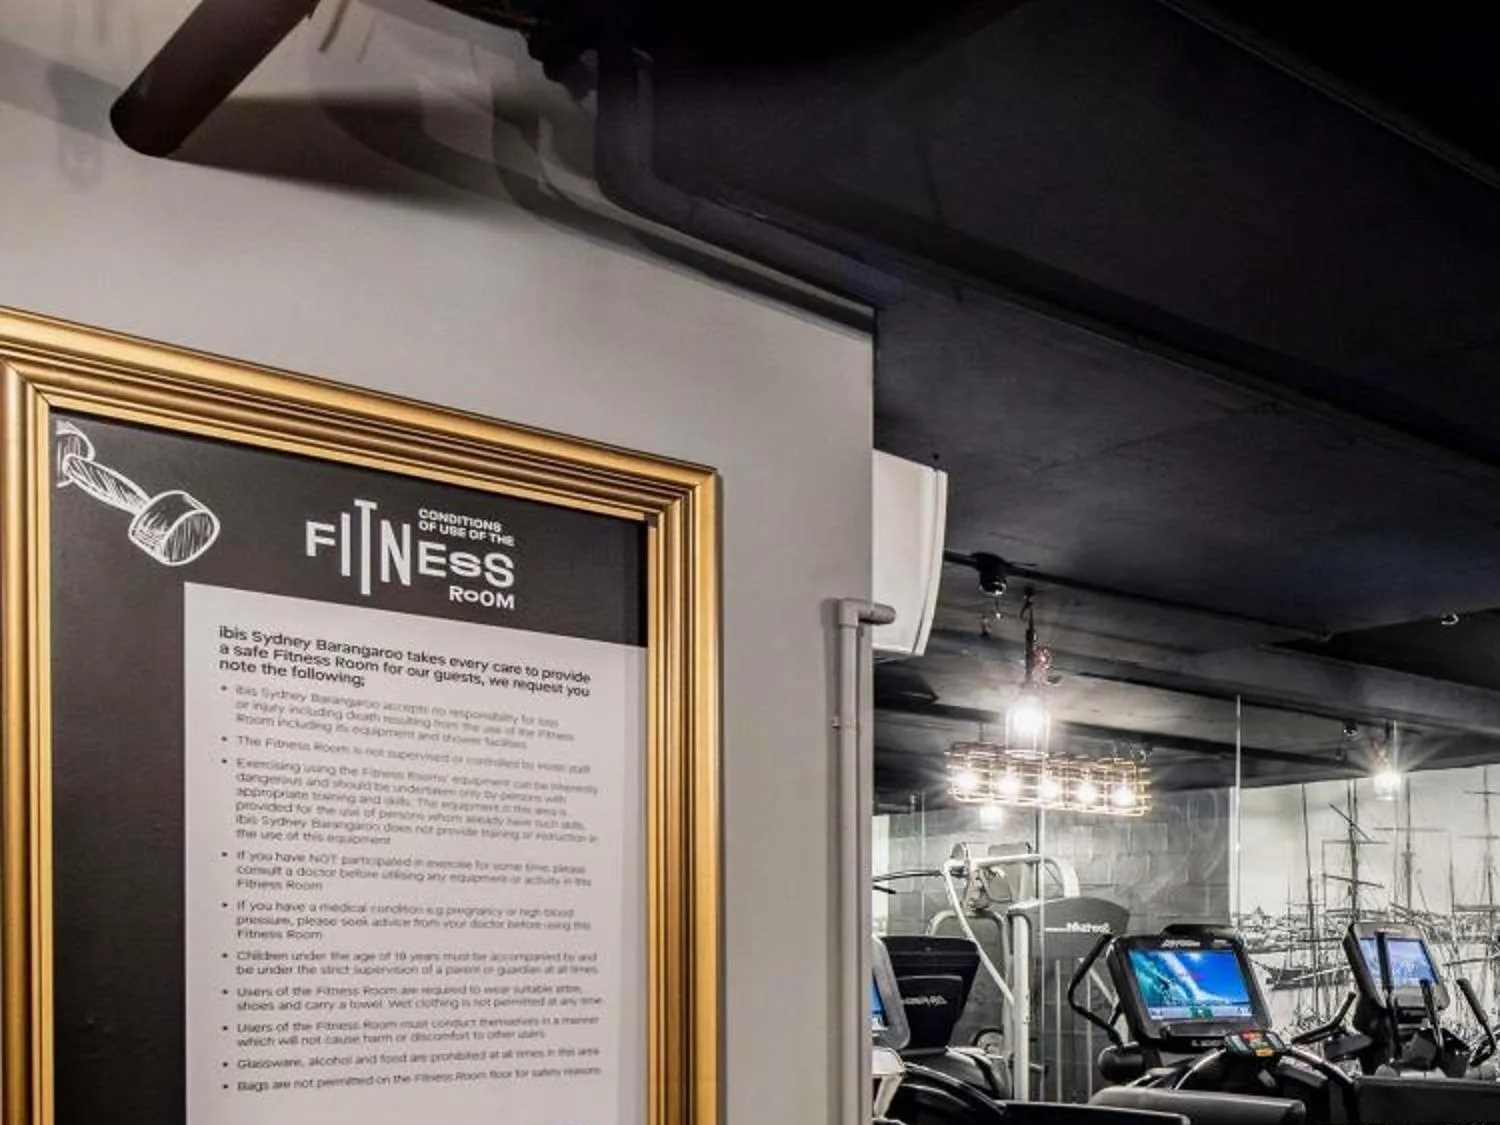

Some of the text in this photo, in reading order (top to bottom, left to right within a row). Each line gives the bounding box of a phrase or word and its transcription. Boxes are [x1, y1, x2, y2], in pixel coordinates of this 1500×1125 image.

[418, 508, 502, 533] CONDITIONS
[419, 521, 515, 547] OF USE OF THE
[219, 626, 590, 683] ibis Sydney Barangaroo takes every care to provide
[219, 644, 589, 696] a safe Fitness Room for our guests, we request you
[219, 660, 365, 687] note the following;
[248, 852, 273, 861] you
[274, 852, 306, 862] have
[307, 853, 338, 863] NOT
[284, 880, 322, 890] Room
[248, 903, 273, 912] you
[274, 902, 306, 911] have
[237, 929, 322, 939] Fitness Room
[274, 987, 289, 996] of
[361, 986, 398, 995] Room
[276, 1001, 302, 1010] and
[472, 998, 491, 1007] not
[274, 1022, 289, 1031] of
[361, 1020, 398, 1029] Room
[300, 1036, 322, 1045] not
[471, 1032, 485, 1040] to
[292, 1078, 314, 1087] not
[392, 1074, 412, 1083] the
